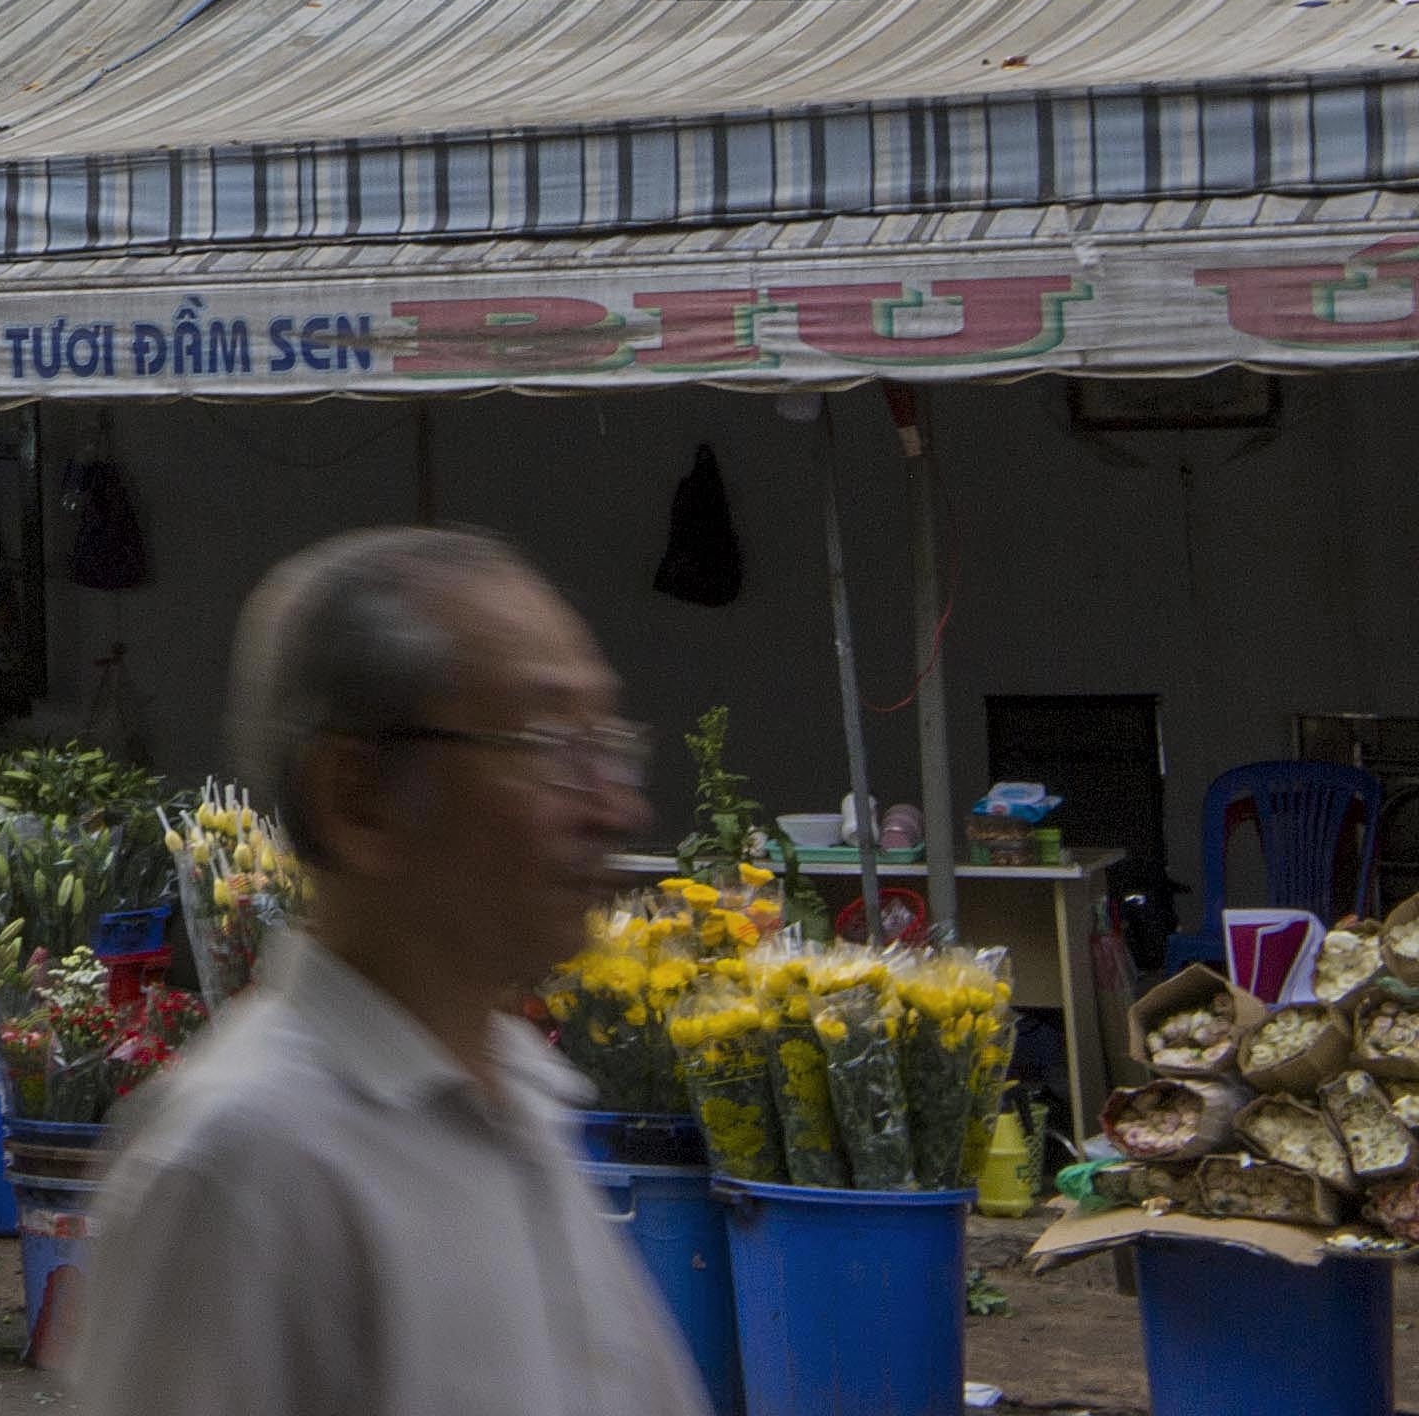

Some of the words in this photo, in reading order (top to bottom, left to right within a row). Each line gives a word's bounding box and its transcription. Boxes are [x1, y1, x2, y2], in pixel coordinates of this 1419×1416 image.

[5, 316, 116, 380] TƯƠI
[131, 295, 251, 375] ĐẦM
[269, 314, 372, 372] SEN
